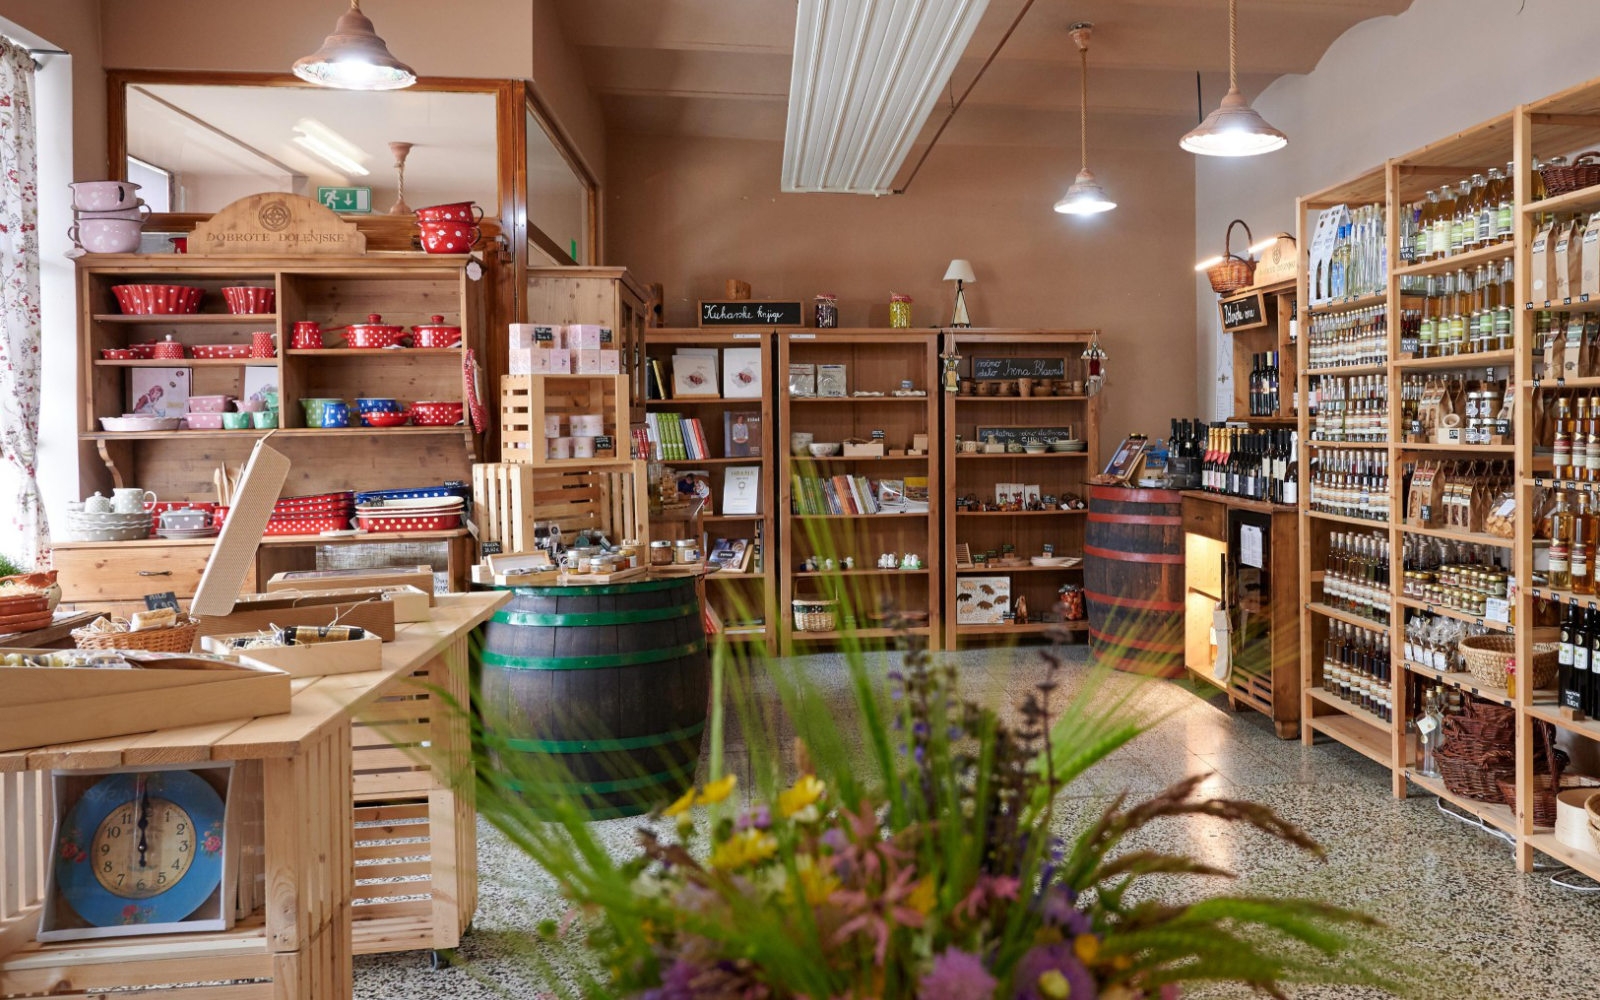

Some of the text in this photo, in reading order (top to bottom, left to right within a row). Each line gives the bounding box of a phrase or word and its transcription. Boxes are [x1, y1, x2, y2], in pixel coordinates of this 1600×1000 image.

[206, 232, 345, 243] DOBROTE DOLENJSKE
[757, 306, 783, 322] knjige
[122, 812, 132, 824] 11
[166, 810, 170, 822] 1
[108, 826, 121, 838] 10
[176, 824, 185, 835] 2
[101, 844, 110, 856] 9
[180, 840, 188, 852] 3
[104, 860, 112, 873] 8
[172, 858, 180, 870] 4
[117, 874, 125, 886] 7
[157, 872, 166, 884] 5
[137, 880, 145, 890] 6
